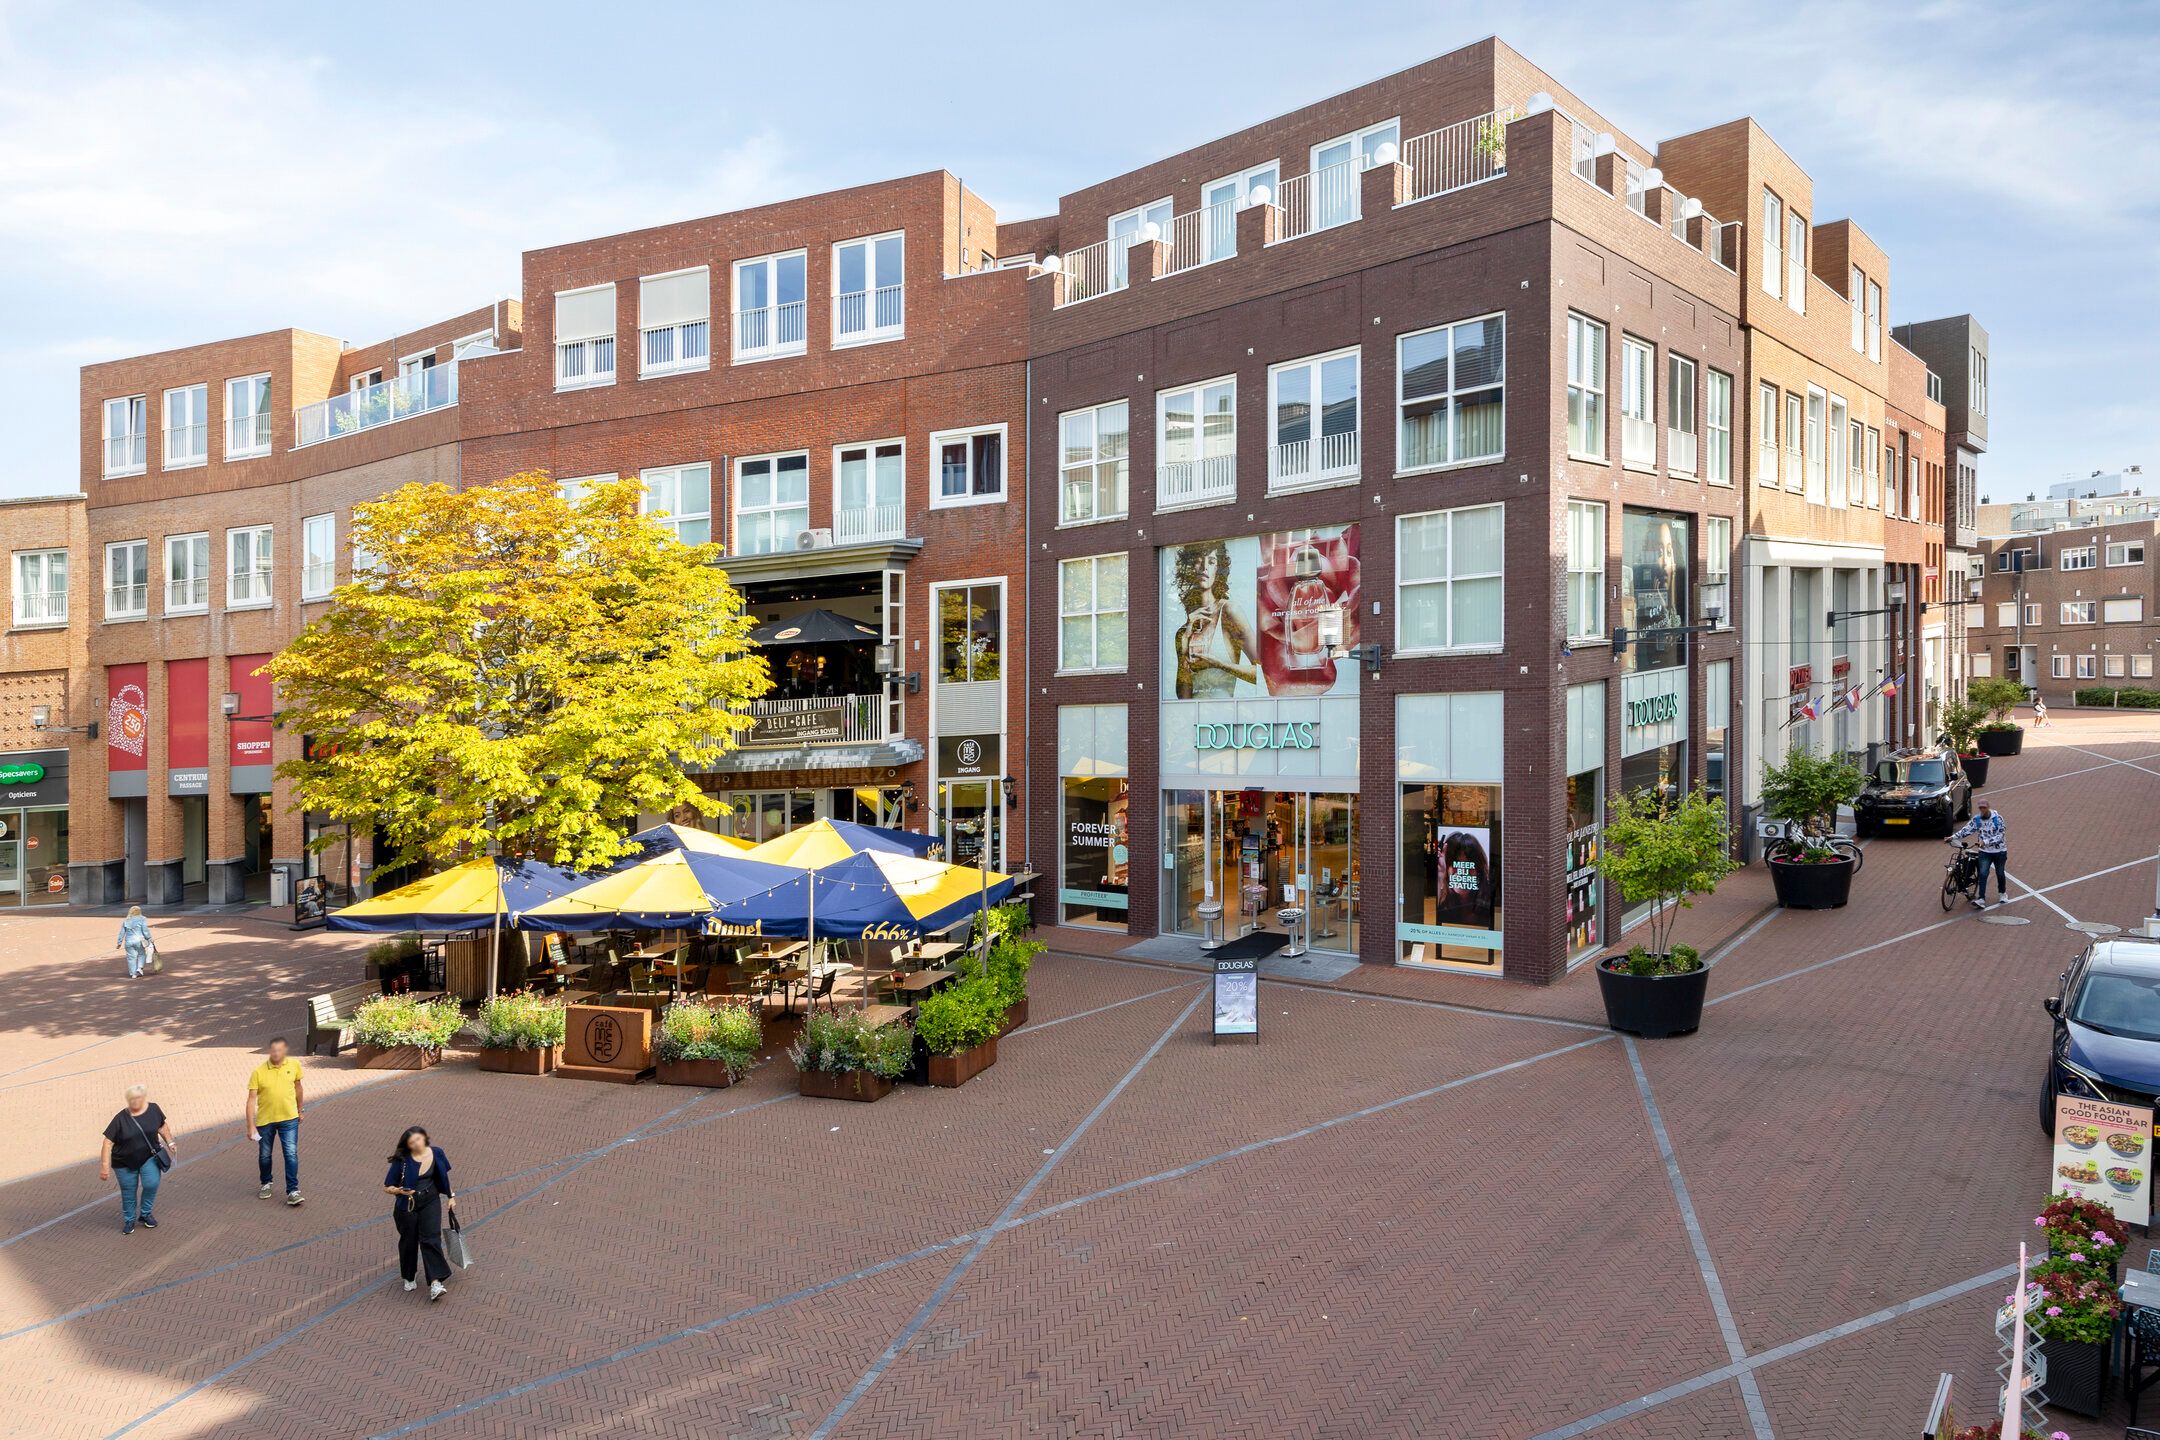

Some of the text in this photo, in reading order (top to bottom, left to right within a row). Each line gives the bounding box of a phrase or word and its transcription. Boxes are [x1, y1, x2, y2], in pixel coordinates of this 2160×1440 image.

[1293, 598, 1303, 606] all
[1304, 596, 1313, 607] of
[1271, 609, 1303, 617] narciso
[1632, 692, 1679, 727] DOUGLAS
[124, 713, 141, 732] 250
[767, 716, 787, 729] DELI
[796, 729, 820, 737] INGANG
[820, 727, 839, 735] BOVEN
[1196, 722, 1314, 750] DOUGLAS
[236, 741, 271, 750] SHOPPEN
[958, 766, 981, 774] INGANG
[173, 773, 208, 782] CENTRUM
[8, 791, 37, 800] Opticiens
[1071, 822, 1116, 835] FOREVER
[1072, 835, 1115, 848] SUMMER
[1452, 861, 1475, 869] MEER
[1457, 868, 1469, 876] BIJ
[49, 879, 63, 887] Sale
[1449, 874, 1477, 883] IEDERE
[1218, 960, 1254, 970] DOUGLAS
[2078, 1102, 2131, 1117] THE ASIAN
[2060, 1107, 2092, 1118] GOOD
[2094, 1112, 2124, 1124] FOOD
[2125, 1118, 2148, 1129] BAR
